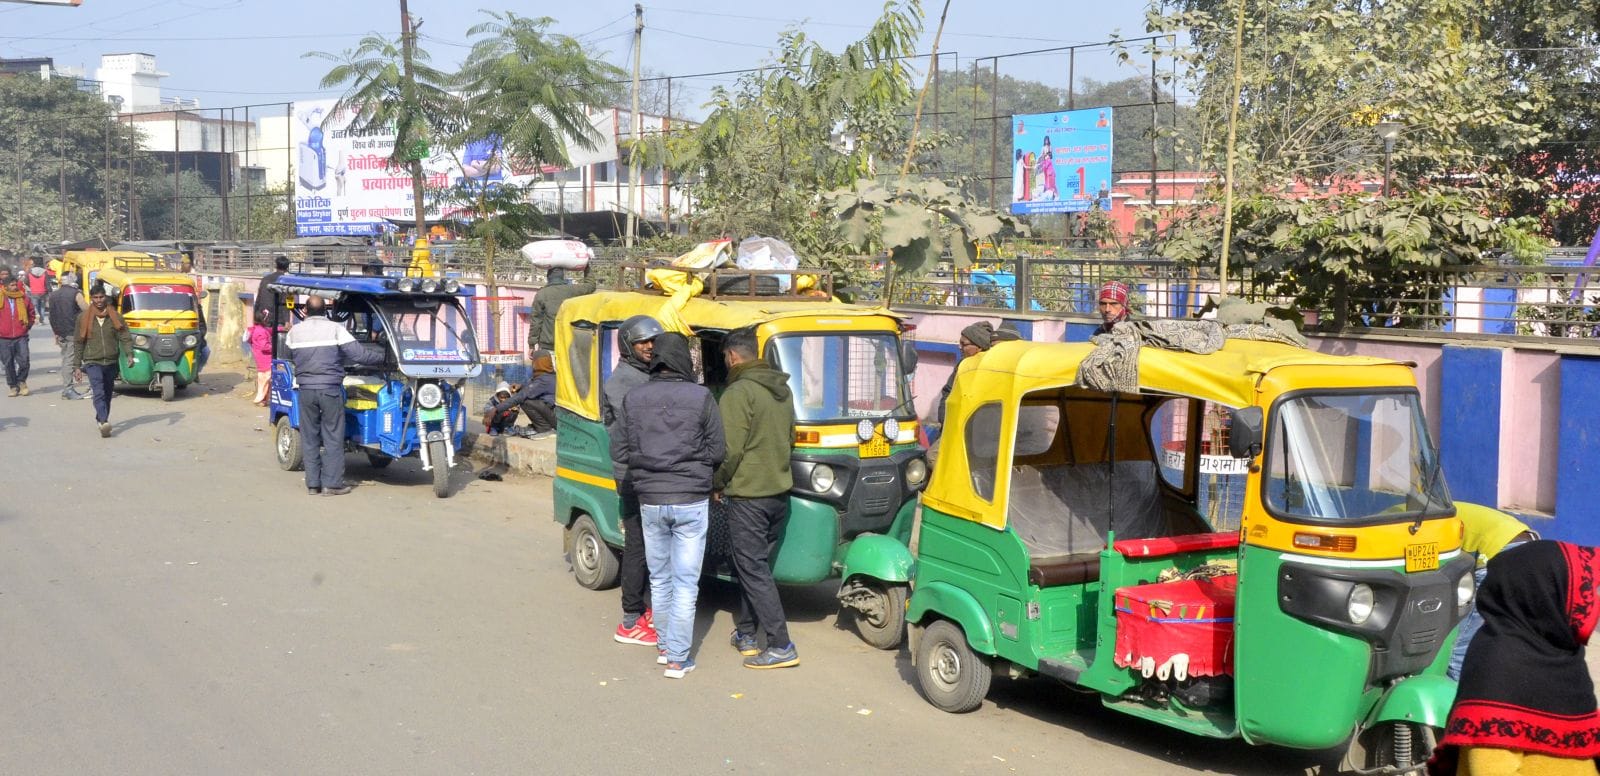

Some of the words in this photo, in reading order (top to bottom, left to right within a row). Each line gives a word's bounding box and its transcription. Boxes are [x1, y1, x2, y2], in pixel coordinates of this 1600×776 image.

[297, 196, 331, 209] रोबोटिक
[337, 206, 349, 221] पूर्ण
[1413, 556, 1436, 570] T7627
